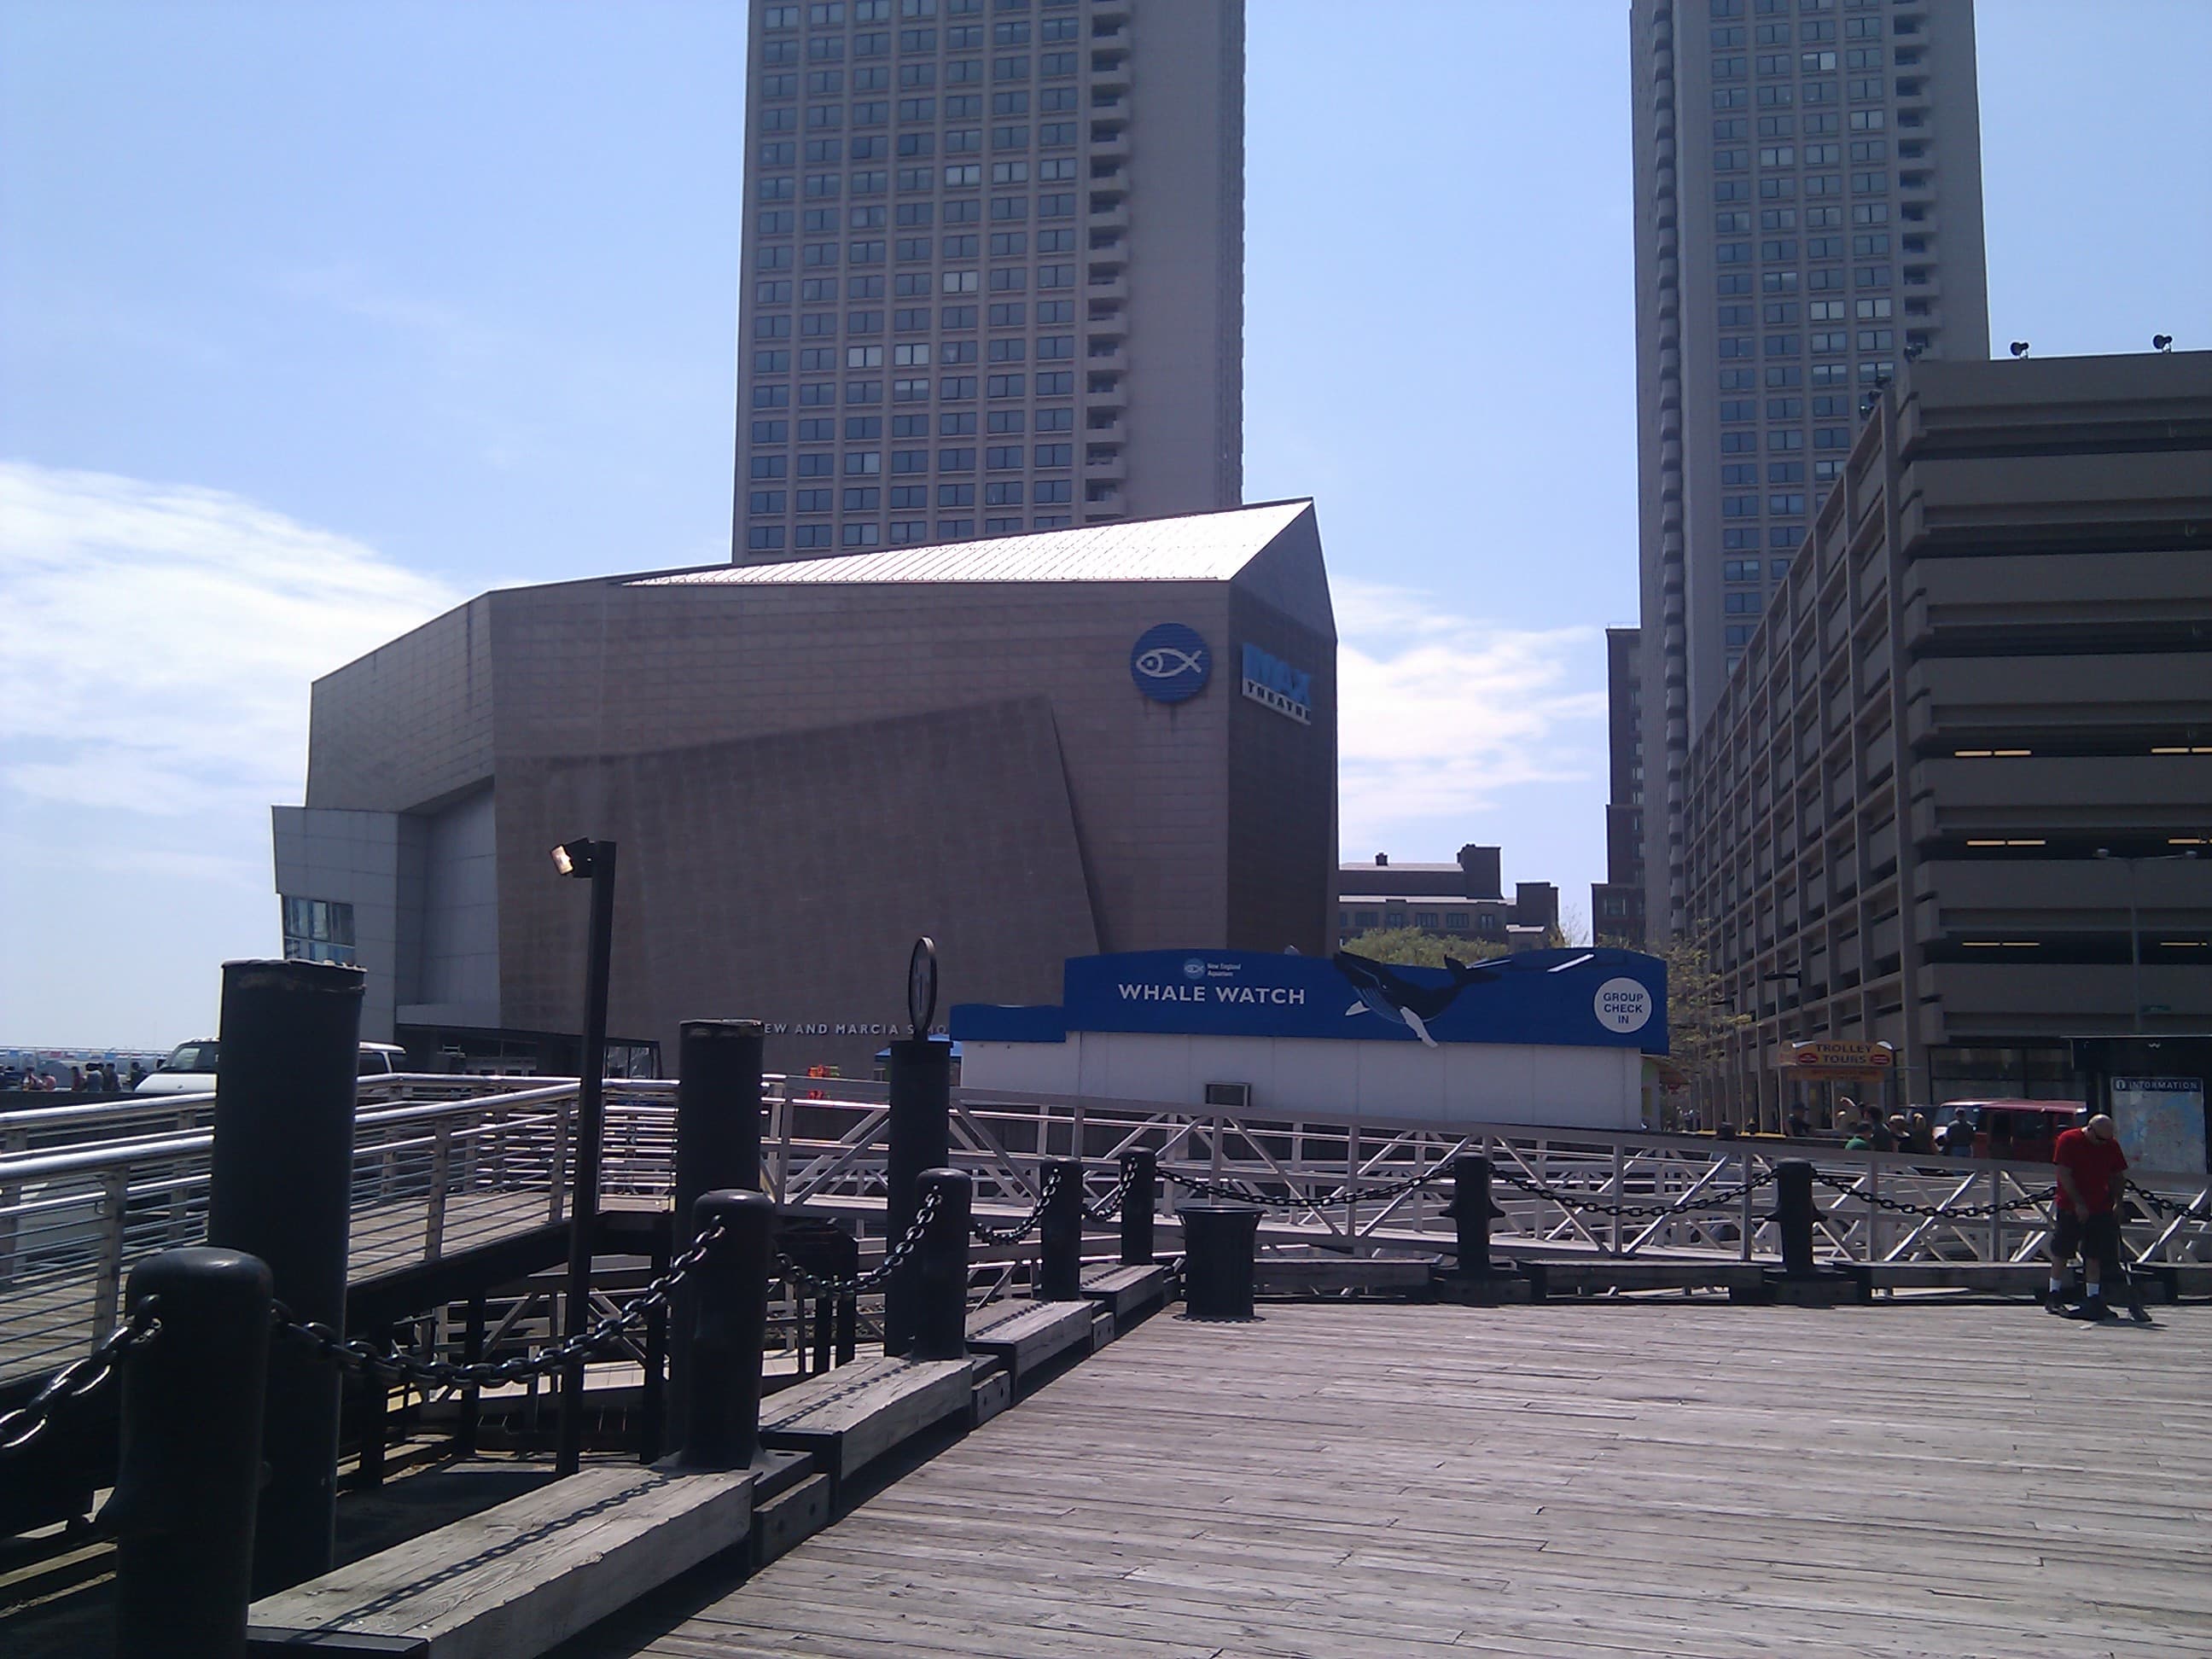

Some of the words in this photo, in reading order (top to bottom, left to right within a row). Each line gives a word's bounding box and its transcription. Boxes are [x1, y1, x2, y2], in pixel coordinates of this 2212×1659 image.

[1247, 681, 1312, 720] THEATRE
[1118, 983, 1206, 1002] WHALE
[1215, 986, 1306, 1004] WATCH
[1603, 992, 1644, 1002] GROUP
[1604, 1003, 1643, 1013] CHECK
[1617, 1015, 1629, 1024] IN
[795, 1023, 828, 1034] AND
[835, 1023, 899, 1034] MARCIA
[1816, 1044, 1872, 1053] TROLLEY
[1823, 1054, 1866, 1063] TOURS
[2129, 1080, 2198, 1090] INFORMATION
